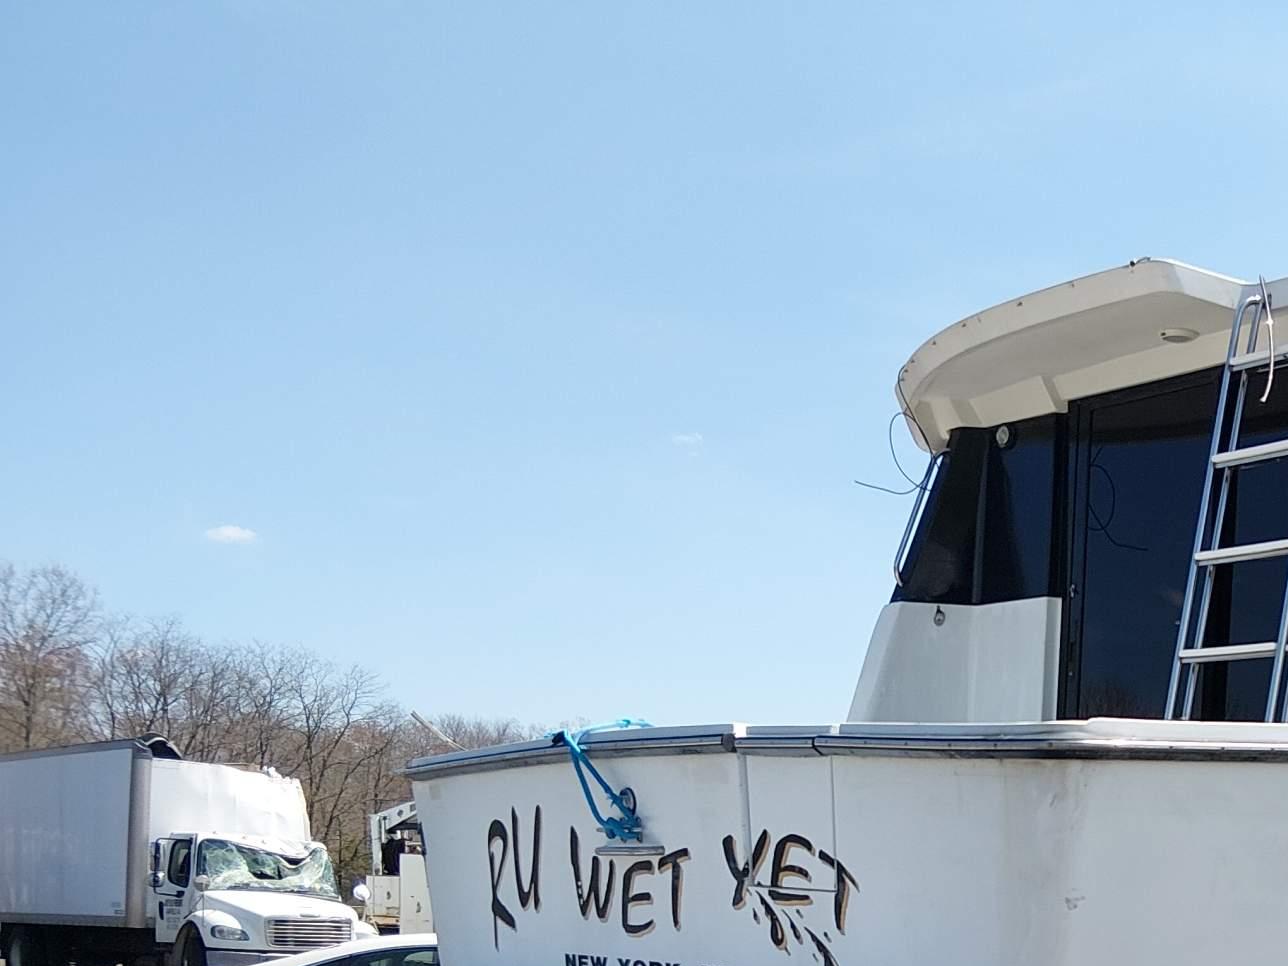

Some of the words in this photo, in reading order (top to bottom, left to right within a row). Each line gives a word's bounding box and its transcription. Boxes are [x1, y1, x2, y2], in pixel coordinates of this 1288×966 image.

[488, 805, 541, 951] RU
[570, 825, 690, 938] WET
[722, 829, 860, 935] YET
